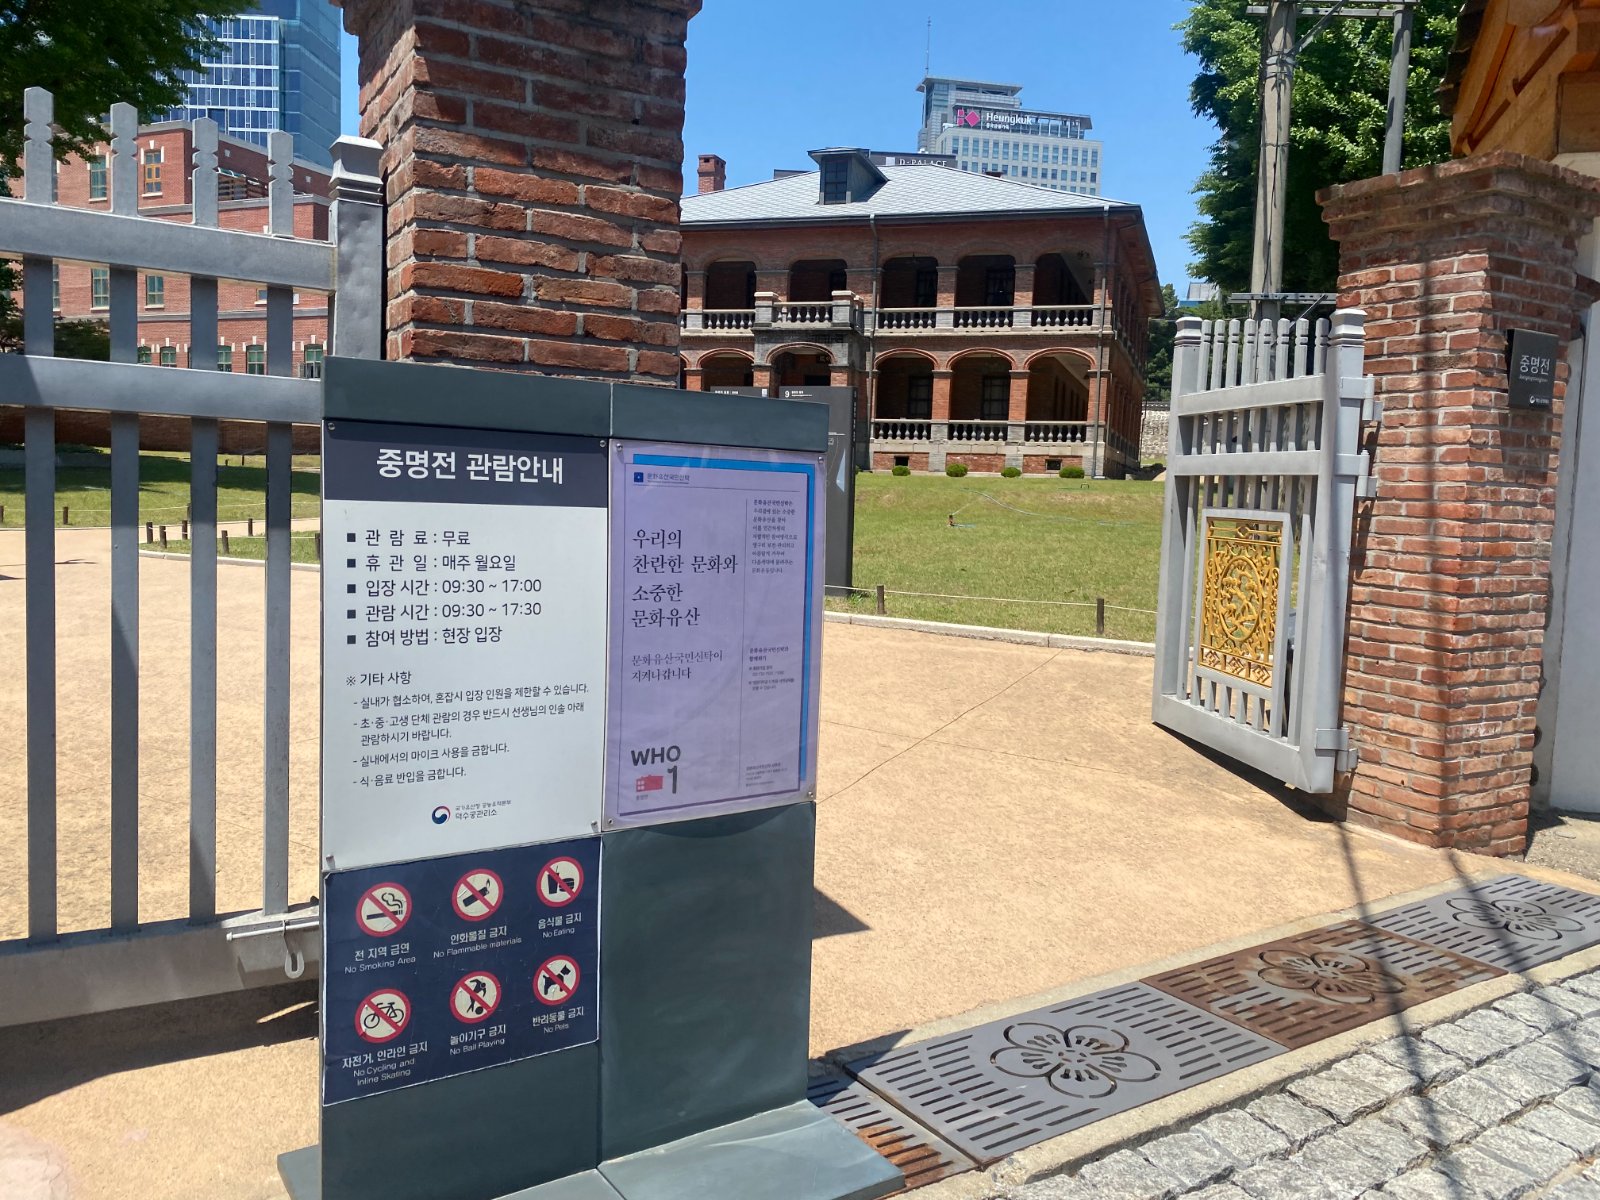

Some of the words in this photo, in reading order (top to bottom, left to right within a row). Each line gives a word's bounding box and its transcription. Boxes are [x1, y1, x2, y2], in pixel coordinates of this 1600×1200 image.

[986, 112, 1031, 126] Heungkuk
[1519, 354, 1551, 375] 중명전
[784, 390, 790, 398] 9
[376, 448, 457, 480] 중명전
[466, 452, 564, 485] 관람안내
[442, 530, 471, 547] 무료
[632, 528, 682, 550] 우리의
[442, 554, 471, 572] 매주
[474, 554, 516, 572] 월요일
[632, 554, 685, 574] 찬란한
[691, 554, 739, 574] 문화와
[366, 579, 396, 597] 입장
[400, 579, 430, 596] 시간
[442, 579, 485, 594] 09:30
[501, 578, 542, 593] 17:00
[631, 582, 684, 603] 소중한
[365, 604, 396, 622] 관람
[400, 604, 430, 621] 시간
[442, 603, 485, 618] 09:30
[501, 602, 542, 617] 17:30
[631, 607, 701, 628] 문화유산
[365, 629, 396, 648] 참여
[400, 628, 429, 647] 방법
[442, 627, 471, 645] 현장
[474, 625, 503, 644] 입장
[632, 649, 723, 667] 문화유산국민신탁이
[360, 672, 385, 686] 기타
[387, 671, 412, 685] 사항
[632, 666, 692, 683] 지켜나갑니다
[360, 695, 390, 710] 실내가
[392, 693, 433, 707] 협소하여,
[435, 690, 463, 704] 혼잡시
[465, 689, 483, 702] 입장
[486, 687, 512, 700] 인원을
[514, 686, 541, 698] 제한할
[543, 686, 552, 696] 수
[553, 683, 589, 696] 있습니다.
[411, 713, 430, 726] 단체
[432, 711, 460, 725] 관람의
[462, 709, 481, 722] 경우
[482, 707, 510, 721] 반드시
[512, 704, 547, 718] 선생님의
[548, 703, 566, 716] 인솔
[567, 701, 585, 713] 아래
[360, 731, 409, 747] 관람하시기
[411, 728, 452, 742] 바랍니다.
[360, 752, 409, 768] 실내에서의
[410, 749, 440, 762] 마이크
[441, 746, 469, 760] 사용을
[471, 743, 510, 757] 금합니다.
[630, 744, 681, 767] WHO
[396, 770, 425, 785] 반입을
[427, 767, 467, 781] 금합니다.
[667, 765, 678, 795] 1
[537, 915, 564, 930] 음식물
[565, 912, 582, 925] 금지
[450, 928, 487, 946] 인화물질
[489, 925, 508, 939] 금지
[542, 930, 553, 939] No
[553, 926, 575, 937] Eating
[354, 949, 365, 962] 전
[367, 946, 388, 960] 지역
[390, 941, 410, 957] 금연
[433, 950, 445, 959] No
[446, 942, 488, 956] Flammable
[489, 936, 523, 949] materials
[344, 965, 357, 975] No
[359, 959, 396, 973] Smoking
[397, 956, 417, 966] Area
[532, 1010, 566, 1027] 반려동물
[568, 1006, 585, 1019] 금지
[450, 1028, 486, 1046] 놀이기구
[488, 1023, 507, 1038] 금지
[543, 1025, 554, 1034] No
[554, 1022, 570, 1032] Pets
[377, 1045, 406, 1062] 인라인
[408, 1040, 428, 1056] 금지
[449, 1047, 461, 1056] No
[463, 1043, 477, 1054] Ball
[478, 1037, 505, 1051] Playing
[353, 1069, 365, 1078] No
[366, 1062, 397, 1076] Cycling
[399, 1058, 415, 1068] and
[357, 1075, 379, 1087] Inline
[381, 1068, 411, 1081] Skating
